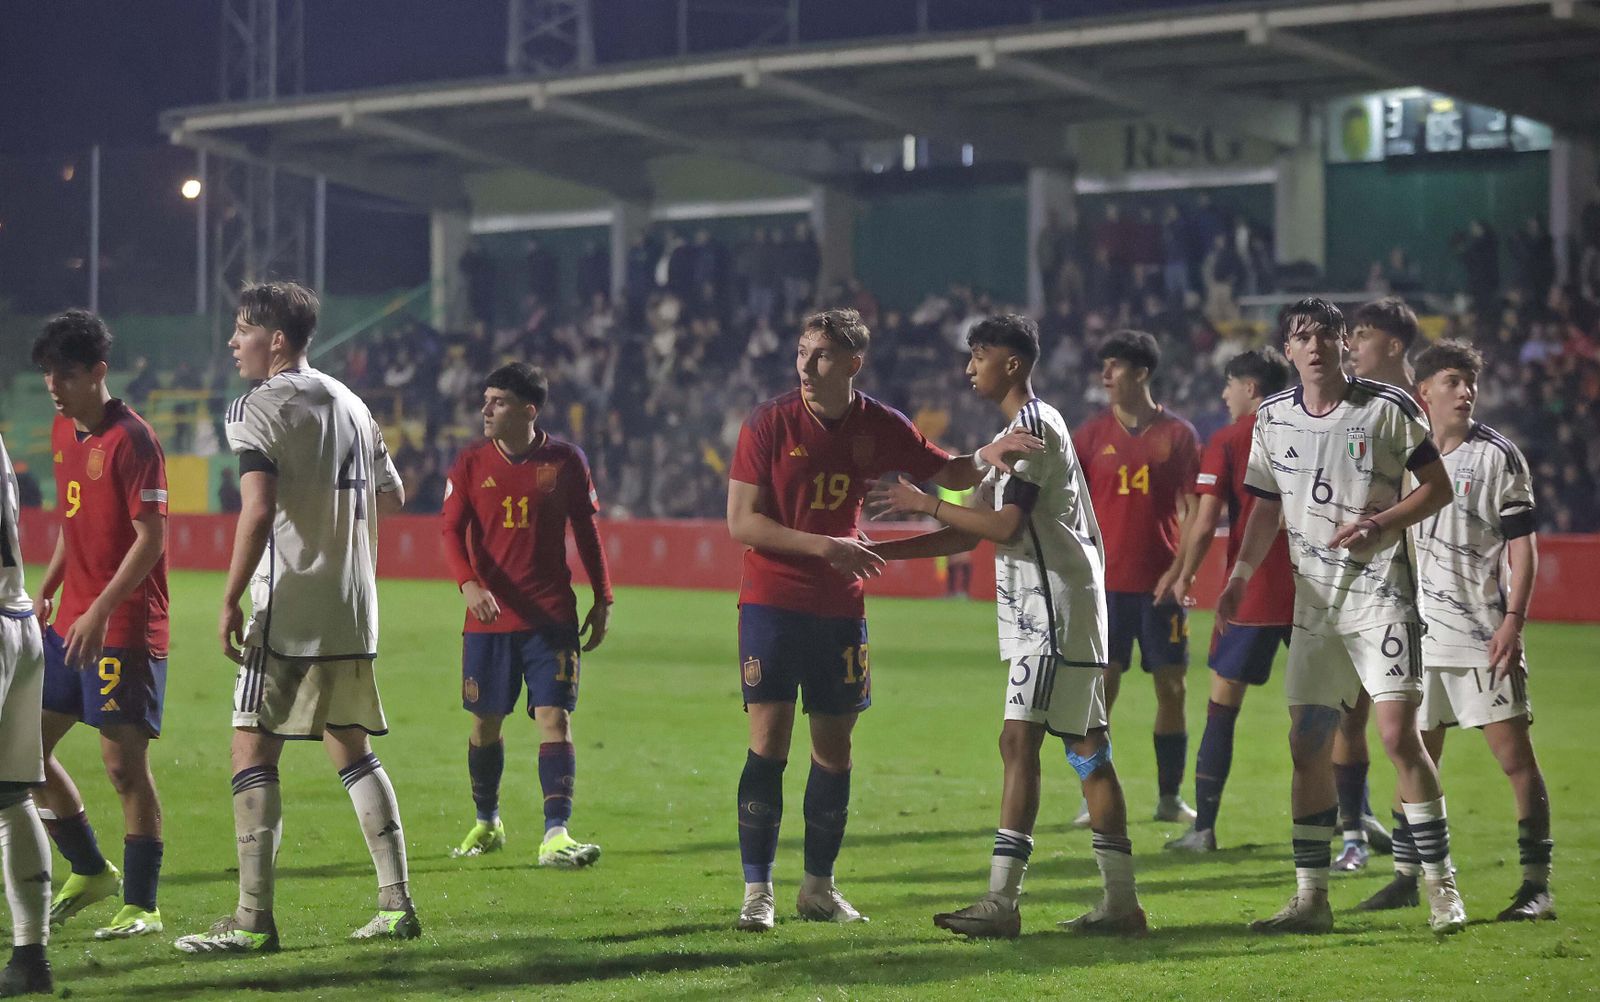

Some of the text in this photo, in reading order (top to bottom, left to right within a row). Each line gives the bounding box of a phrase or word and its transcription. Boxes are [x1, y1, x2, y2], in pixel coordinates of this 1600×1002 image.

[334, 430, 366, 520] 4
[810, 472, 850, 511] 19
[1117, 464, 1149, 495] 14
[1311, 467, 1333, 504] 6
[65, 480, 81, 518] 9
[502, 496, 530, 528] 11
[1381, 623, 1404, 658] 6
[98, 656, 121, 695] 9
[555, 650, 578, 684] 11
[841, 643, 868, 684] 19
